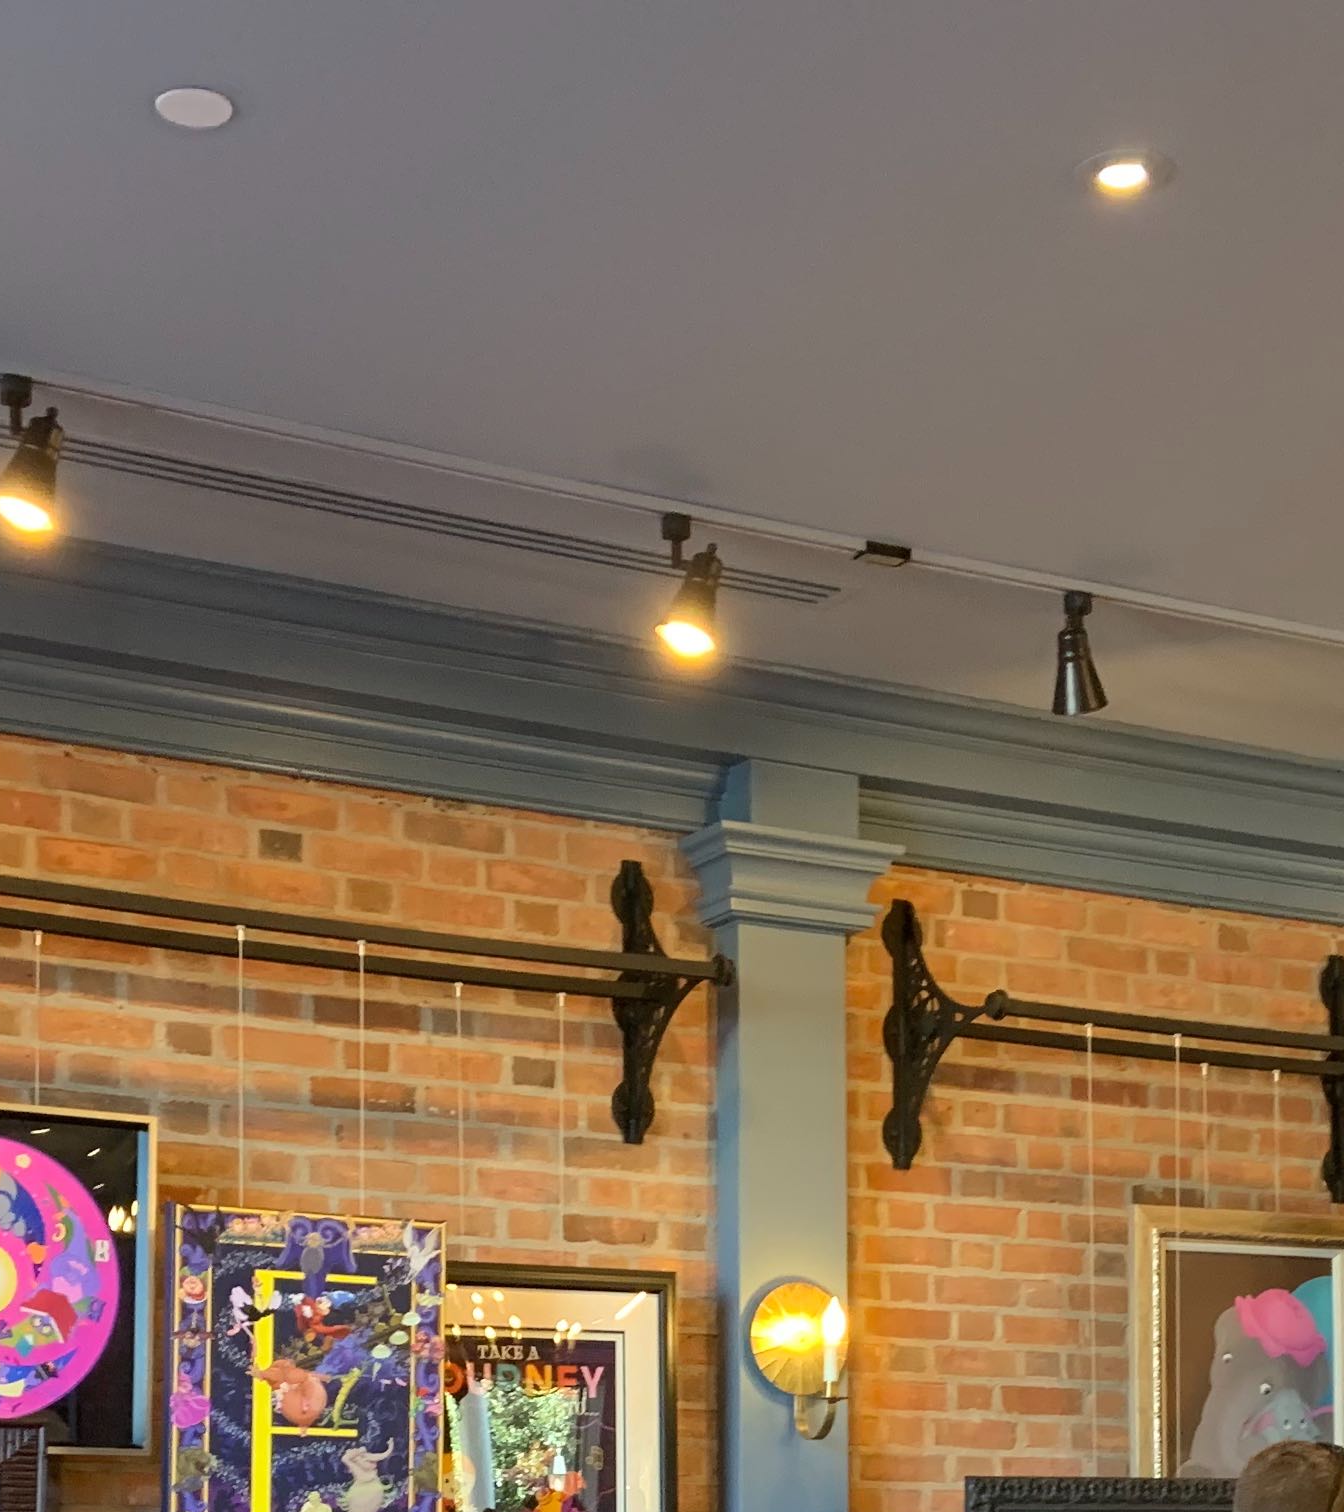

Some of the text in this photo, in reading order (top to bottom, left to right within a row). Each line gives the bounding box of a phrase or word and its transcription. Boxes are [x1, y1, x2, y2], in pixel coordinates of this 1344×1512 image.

[477, 1344, 540, 1361] TAKE A
[444, 1360, 605, 1399] OURNEY
